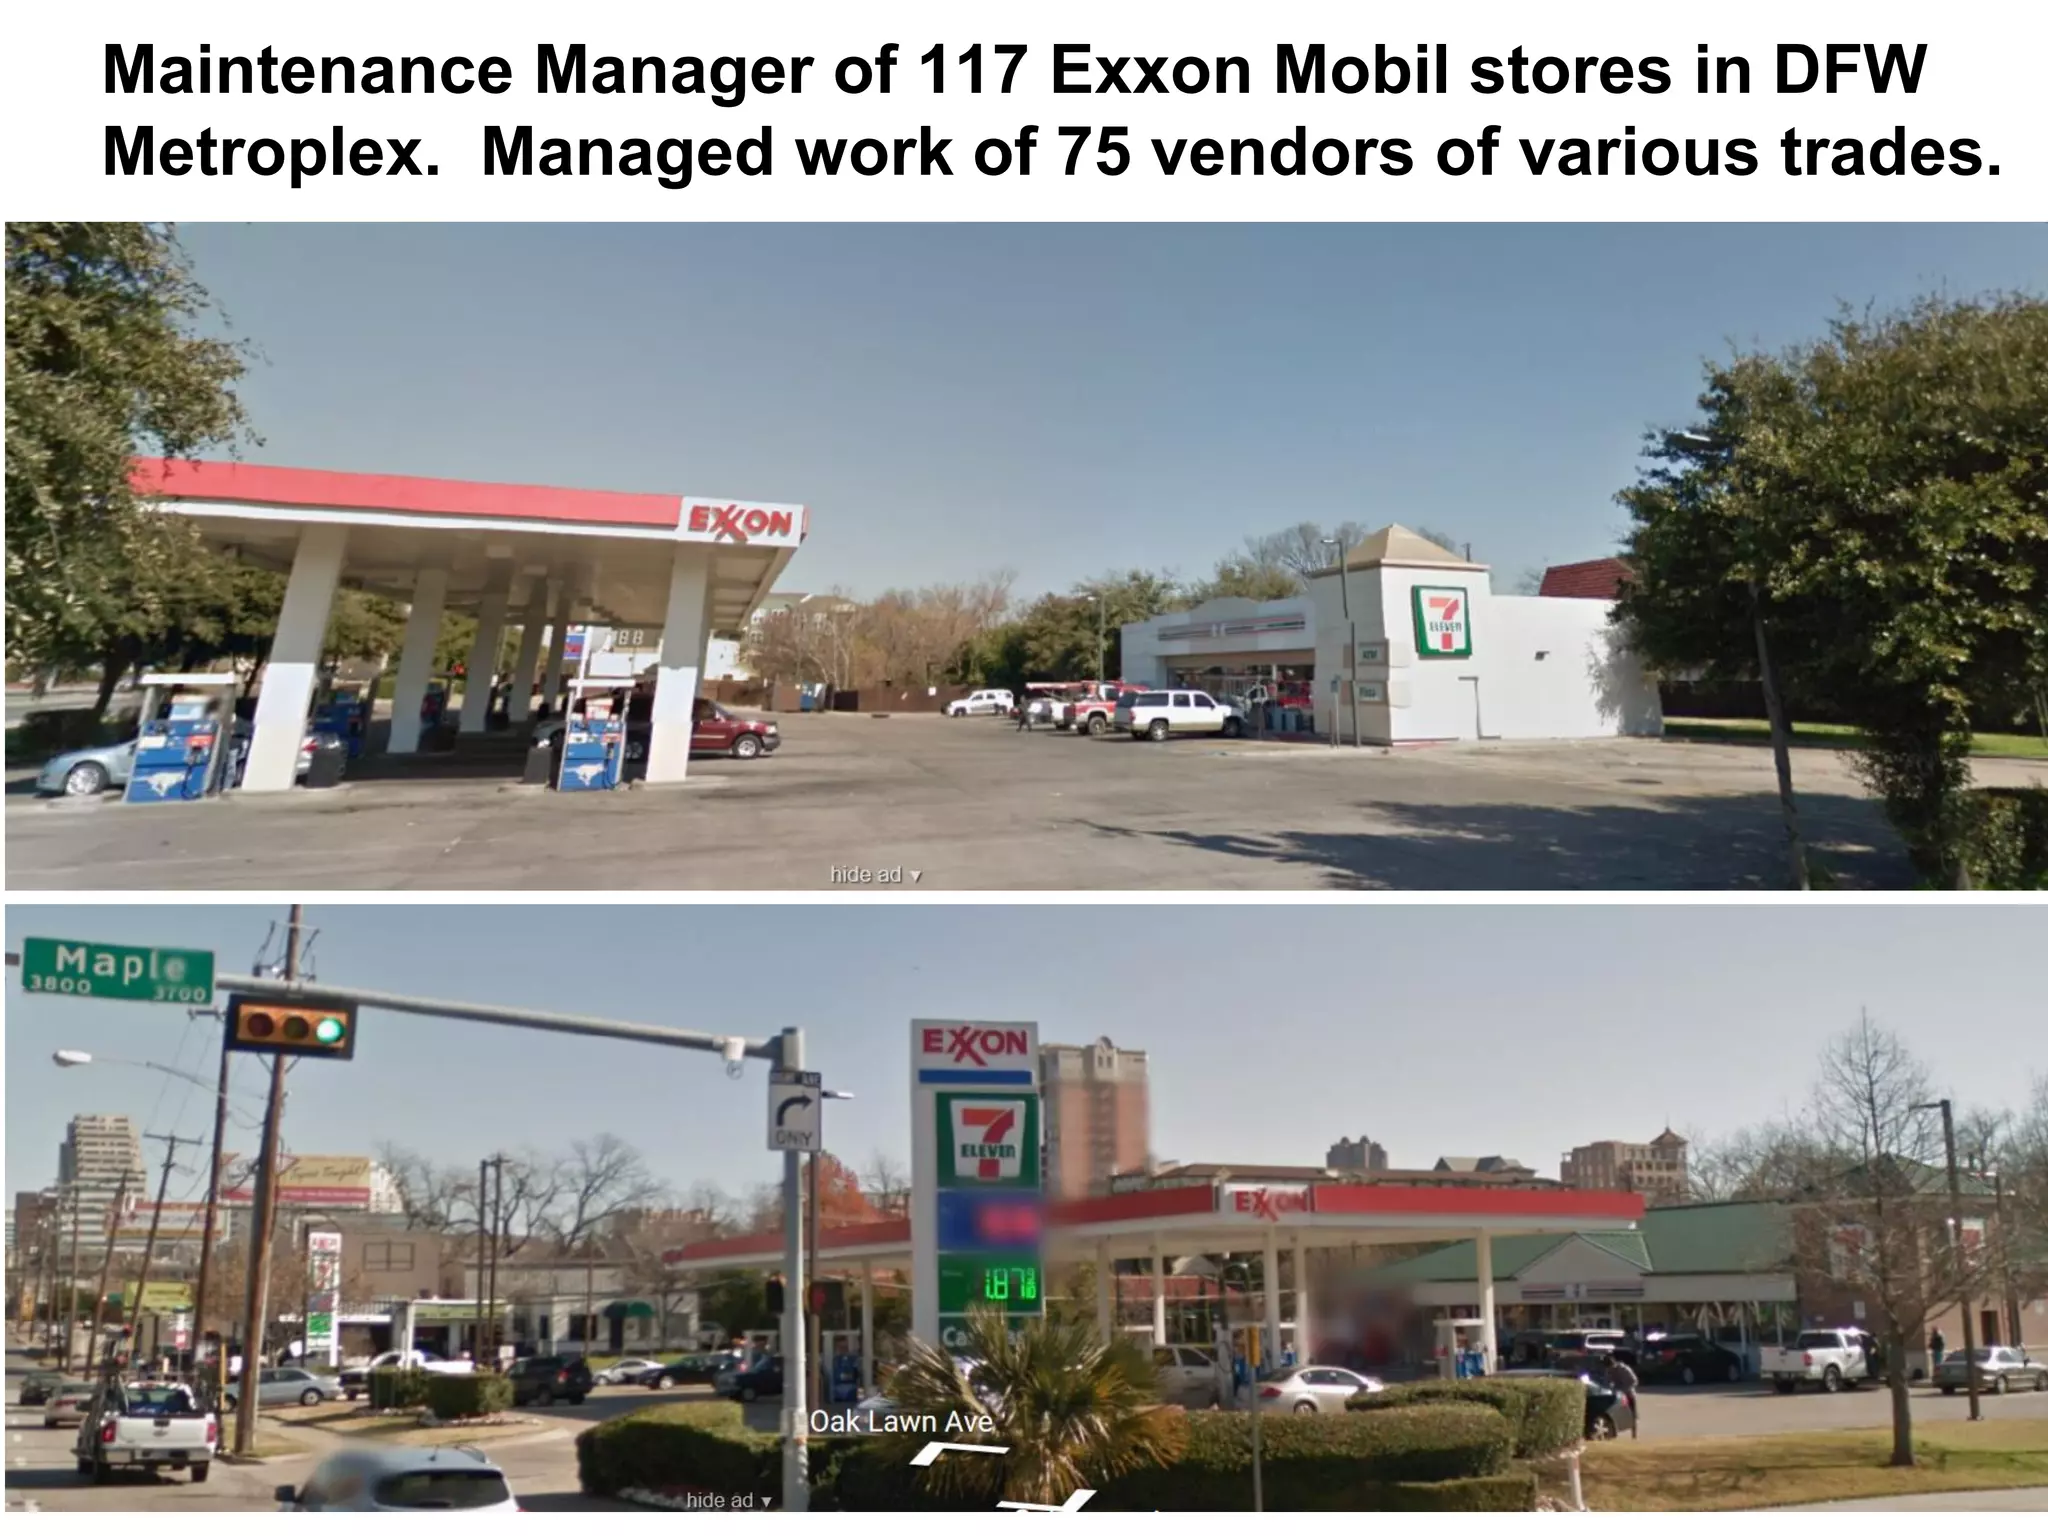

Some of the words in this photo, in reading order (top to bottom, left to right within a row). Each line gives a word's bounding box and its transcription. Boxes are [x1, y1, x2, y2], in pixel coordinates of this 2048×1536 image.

[688, 504, 793, 542] EXXON
[1429, 597, 1460, 650] 7
[30, 974, 92, 994] 3800
[55, 944, 188, 986] Maple
[154, 985, 207, 1001] 3700
[922, 1026, 1028, 1067] EXXON
[961, 1107, 1015, 1179] 7
[1235, 1187, 1309, 1223] EXXON
